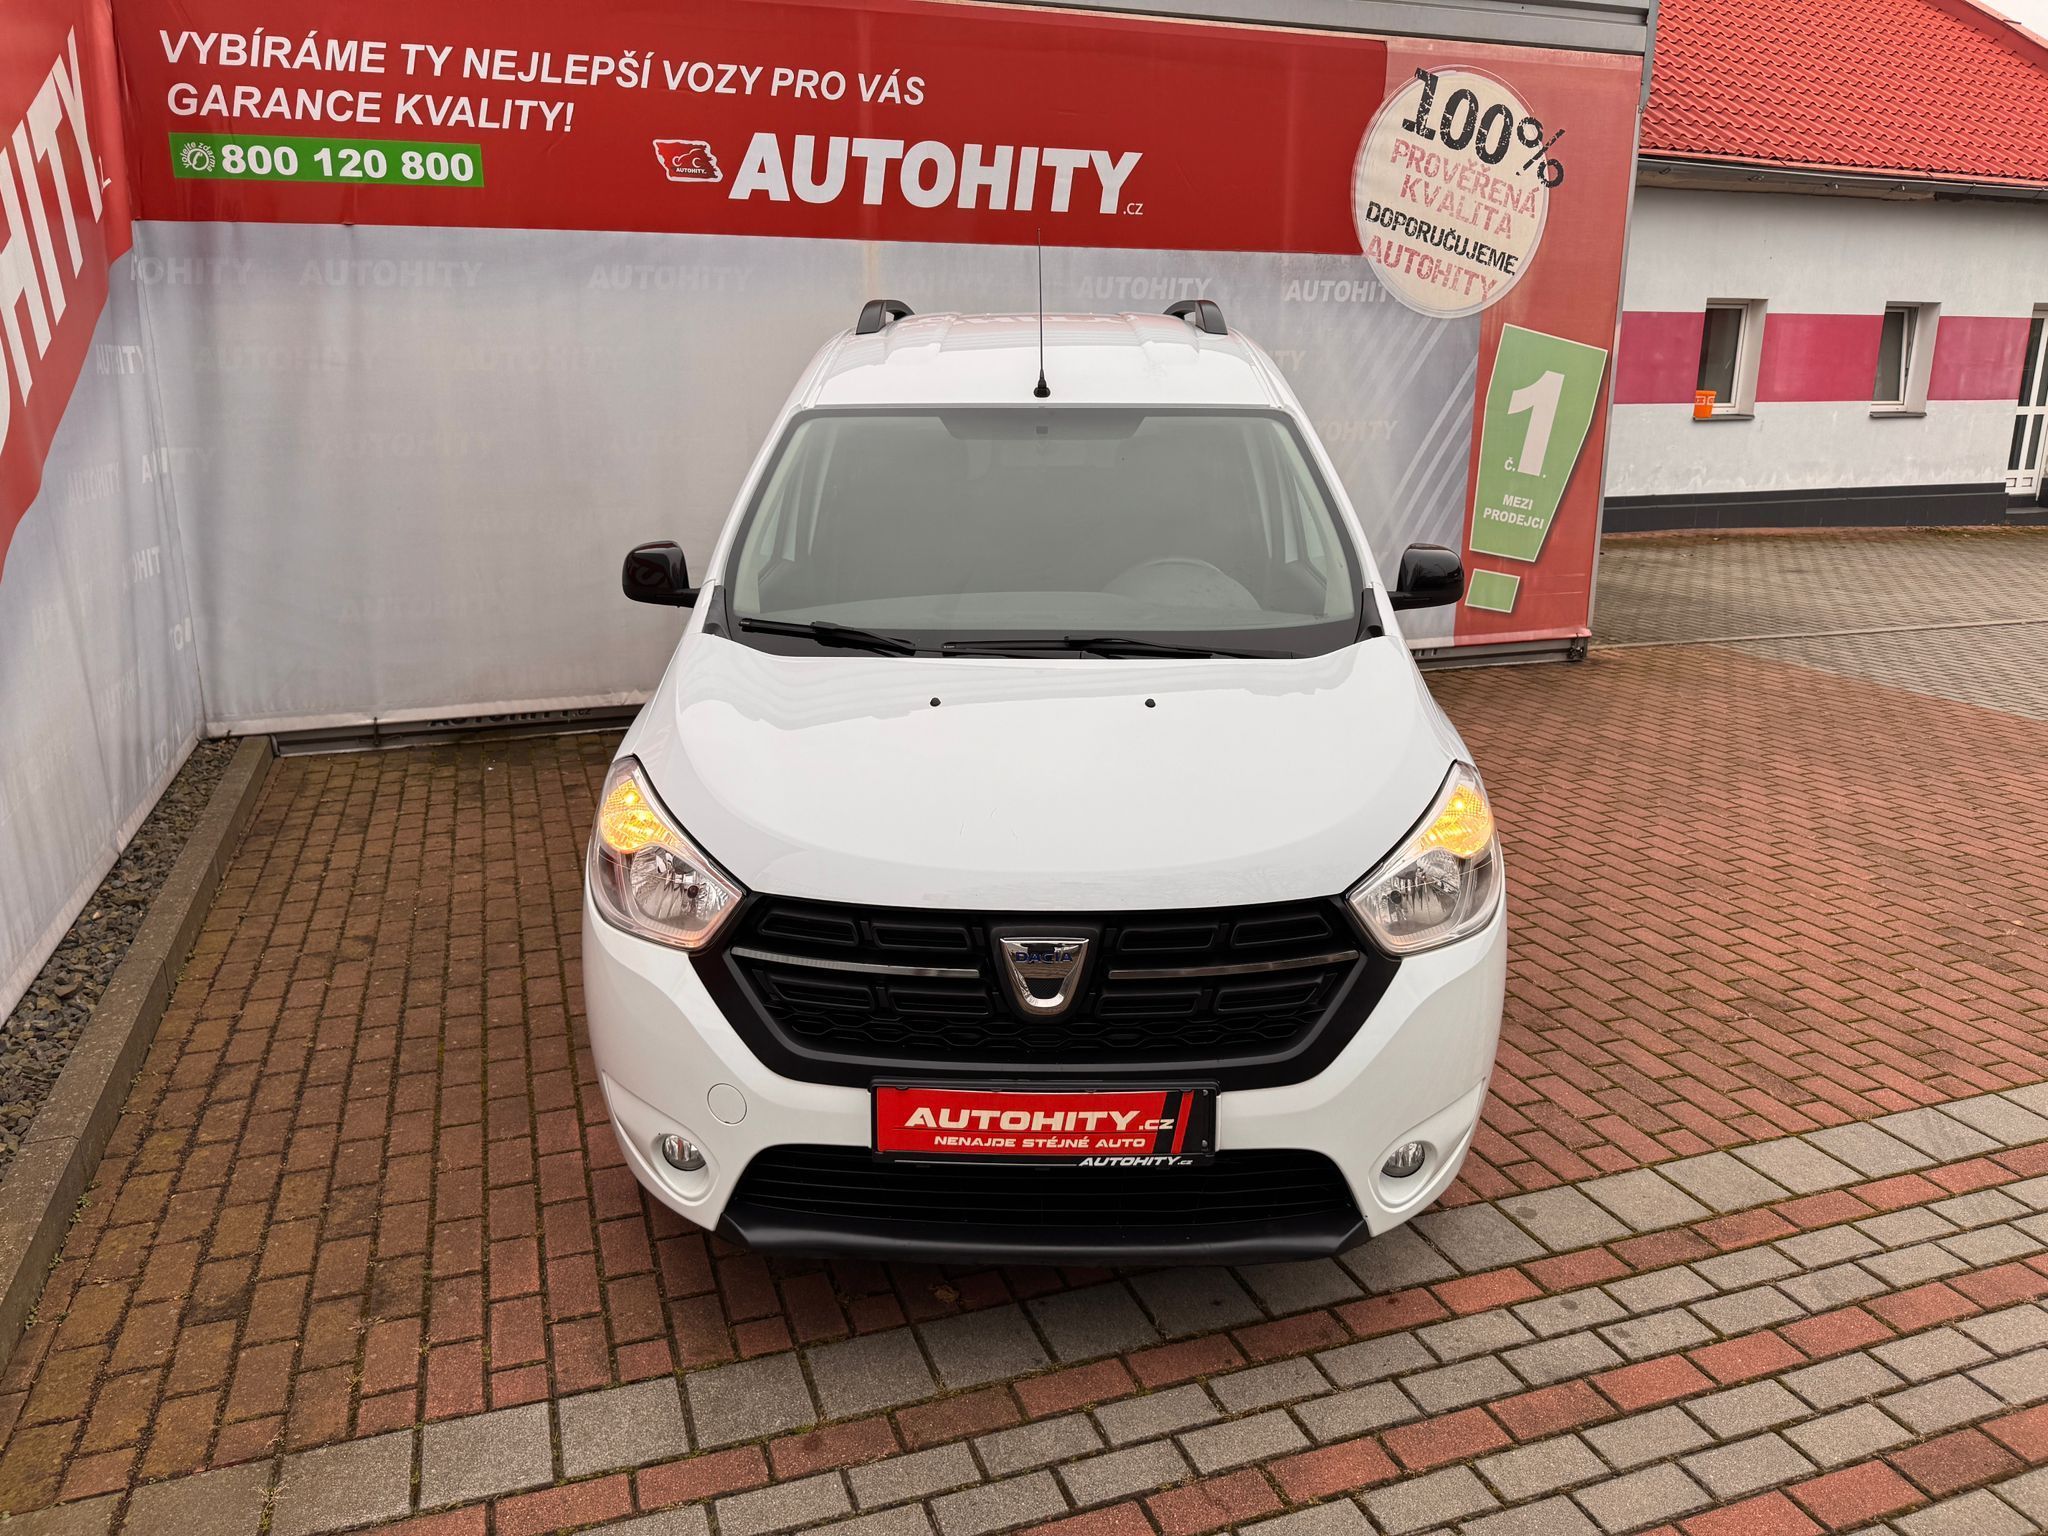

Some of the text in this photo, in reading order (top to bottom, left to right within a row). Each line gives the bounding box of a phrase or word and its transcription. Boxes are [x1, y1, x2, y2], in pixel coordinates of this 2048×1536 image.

[159, 27, 926, 105] VYBÍRÁME TY NEJLEPŠÍ VOZY PRO VÁS
[167, 83, 575, 133] GARANCE KVALITY!
[1401, 67, 1566, 188] 100%
[221, 144, 474, 182] 800 120 800
[1391, 138, 1540, 219] PROVĚŘENÁ
[1400, 174, 1513, 239] KVALITA
[1365, 200, 1519, 276] DOPORUČUJEME
[300, 259, 484, 288] AUTOHITY
[1077, 275, 1213, 300] AUTOHITY
[1284, 279, 1400, 303] AUTOHIT
[1367, 235, 1497, 300] AUTOHITY
[1483, 507, 1545, 530] PRODEJCI
[1502, 494, 1534, 511] MEZI
[1015, 951, 1074, 964] DACIA
[934, 1135, 1017, 1149] NENAJDE
[1095, 1138, 1146, 1149] AUTO
